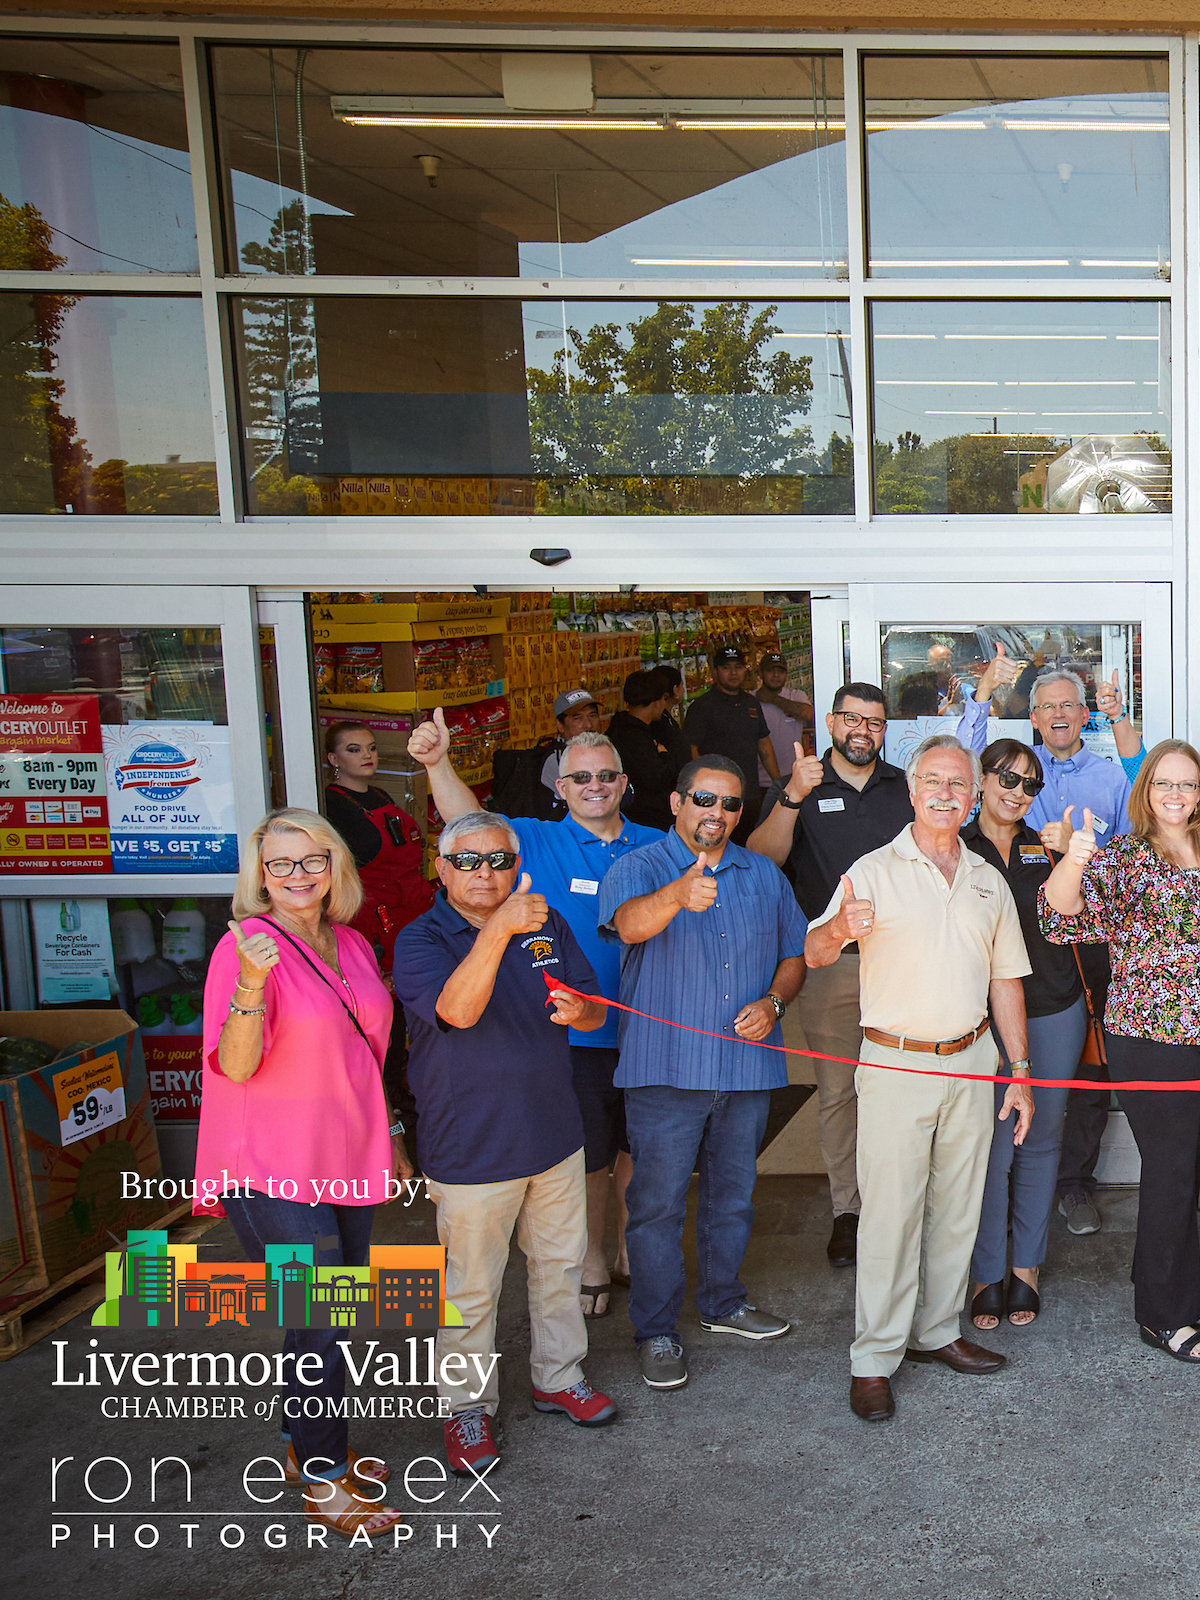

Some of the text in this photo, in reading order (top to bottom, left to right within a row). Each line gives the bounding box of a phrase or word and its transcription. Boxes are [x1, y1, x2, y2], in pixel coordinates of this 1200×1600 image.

[341, 483, 363, 494] Nilla
[368, 482, 391, 494] Nilla
[51, 701, 65, 714] to
[1082, 721, 1111, 731] ASS
[36, 735, 74, 745] market
[23, 760, 54, 772] 8am
[66, 759, 97, 775] 9pm
[126, 769, 191, 780] INDEPENDENCE
[27, 777, 66, 793] Every
[70, 777, 96, 793] Day
[149, 780, 171, 788] from
[145, 790, 178, 800] HUNGER
[121, 814, 200, 823] ALL OF JULY
[143, 840, 164, 854] $5,
[167, 840, 200, 853] GET
[56, 933, 88, 943] Recycle
[55, 948, 92, 956] For Cash
[153, 1048, 166, 1060] to
[167, 1050, 196, 1064] your
[86, 1075, 112, 1091] MEXICO
